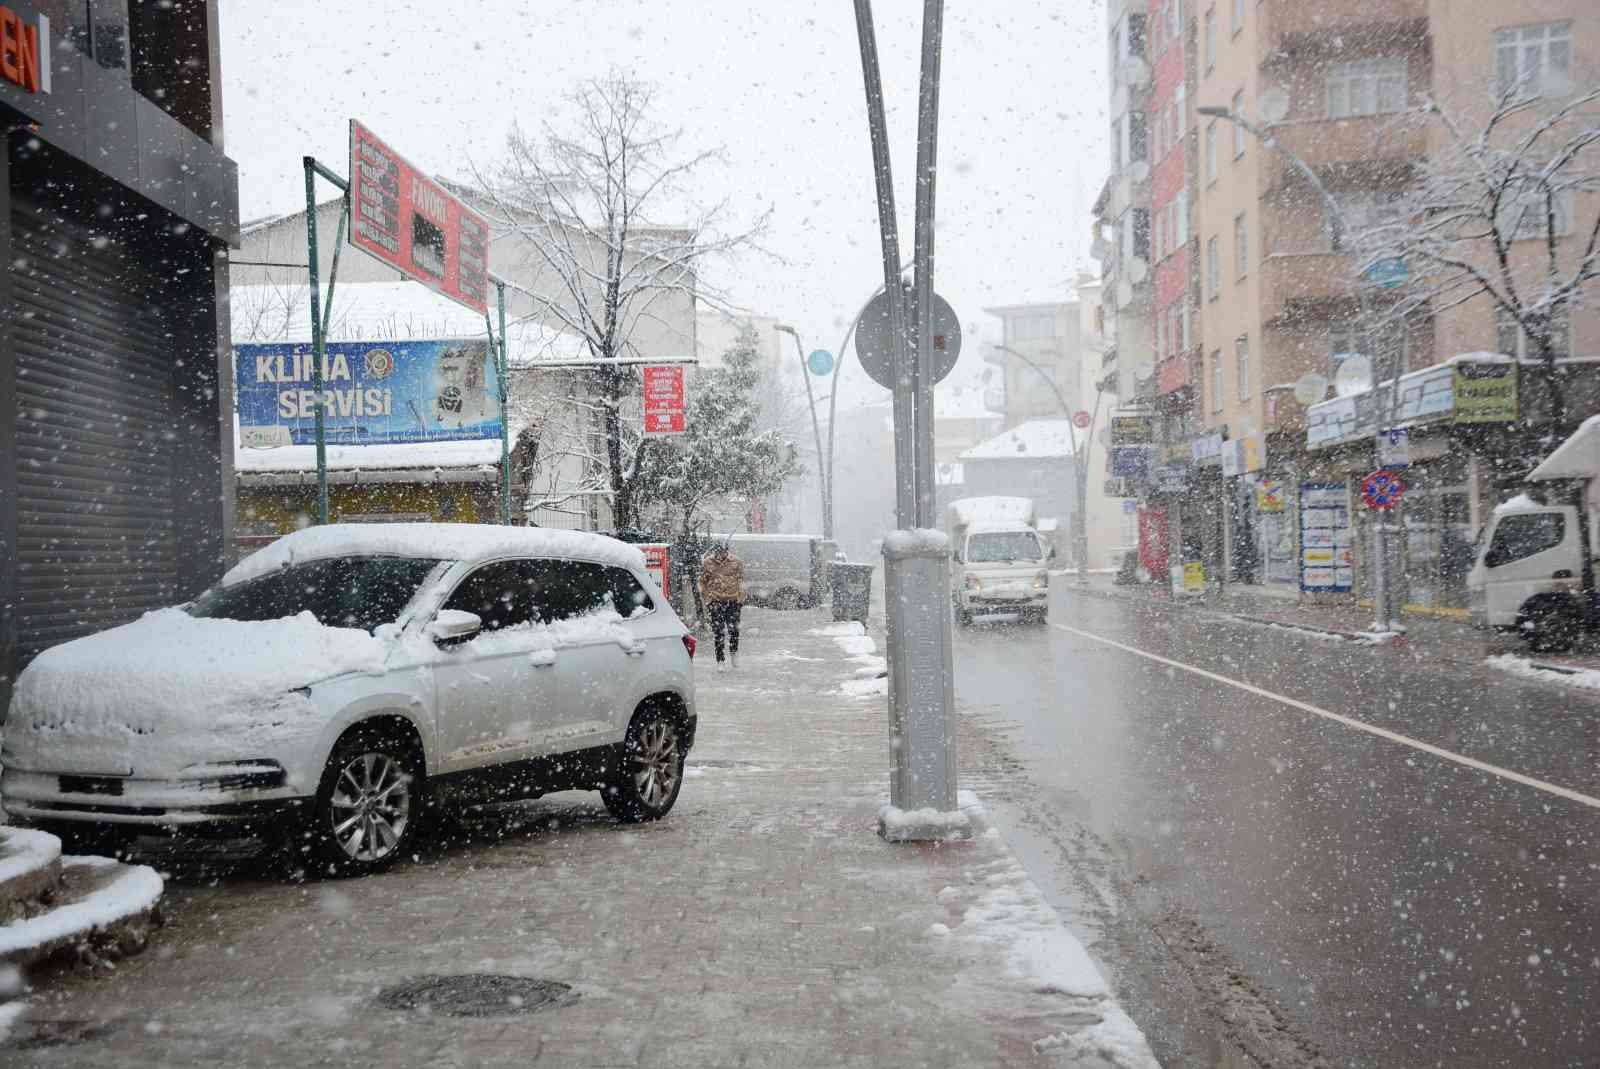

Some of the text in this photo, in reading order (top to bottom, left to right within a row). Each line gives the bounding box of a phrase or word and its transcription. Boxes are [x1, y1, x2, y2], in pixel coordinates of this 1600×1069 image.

[0, 7, 38, 92] EN
[256, 347, 351, 383] KLİMA
[279, 383, 392, 418] SERVİSİ
